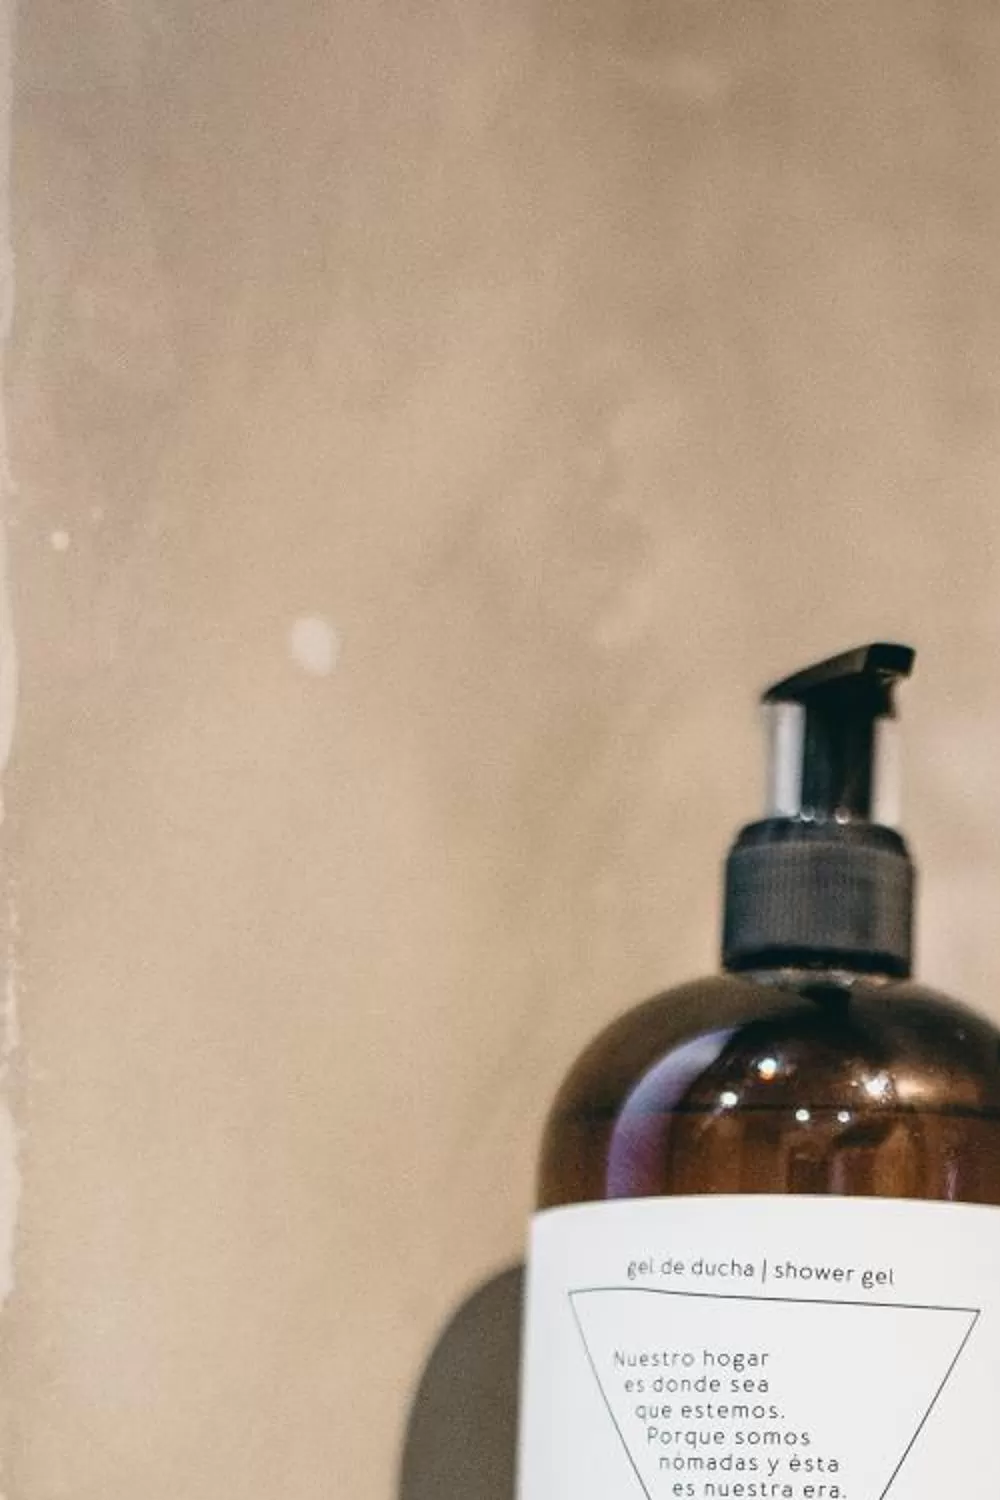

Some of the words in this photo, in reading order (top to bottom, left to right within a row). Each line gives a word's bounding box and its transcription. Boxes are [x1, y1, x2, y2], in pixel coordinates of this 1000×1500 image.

[626, 1256, 653, 1281] gel
[660, 1256, 686, 1277] de
[690, 1257, 756, 1279] ducha
[773, 1259, 856, 1283] shower
[860, 1267, 896, 1290] gel
[612, 1348, 696, 1370] Nuestro
[702, 1349, 770, 1372] hogar
[623, 1377, 646, 1395] es
[651, 1373, 722, 1395] donde
[729, 1377, 770, 1394] sea
[634, 1402, 673, 1422] que
[680, 1401, 786, 1421] estemos.
[645, 1425, 726, 1447] Porque
[734, 1430, 812, 1446] somos
[658, 1453, 759, 1473] nómadas
[766, 1457, 780, 1477] y
[788, 1453, 840, 1474] ésta
[671, 1481, 696, 1498] es
[703, 1479, 795, 1499] nuestra
[801, 1483, 848, 1500] era.
